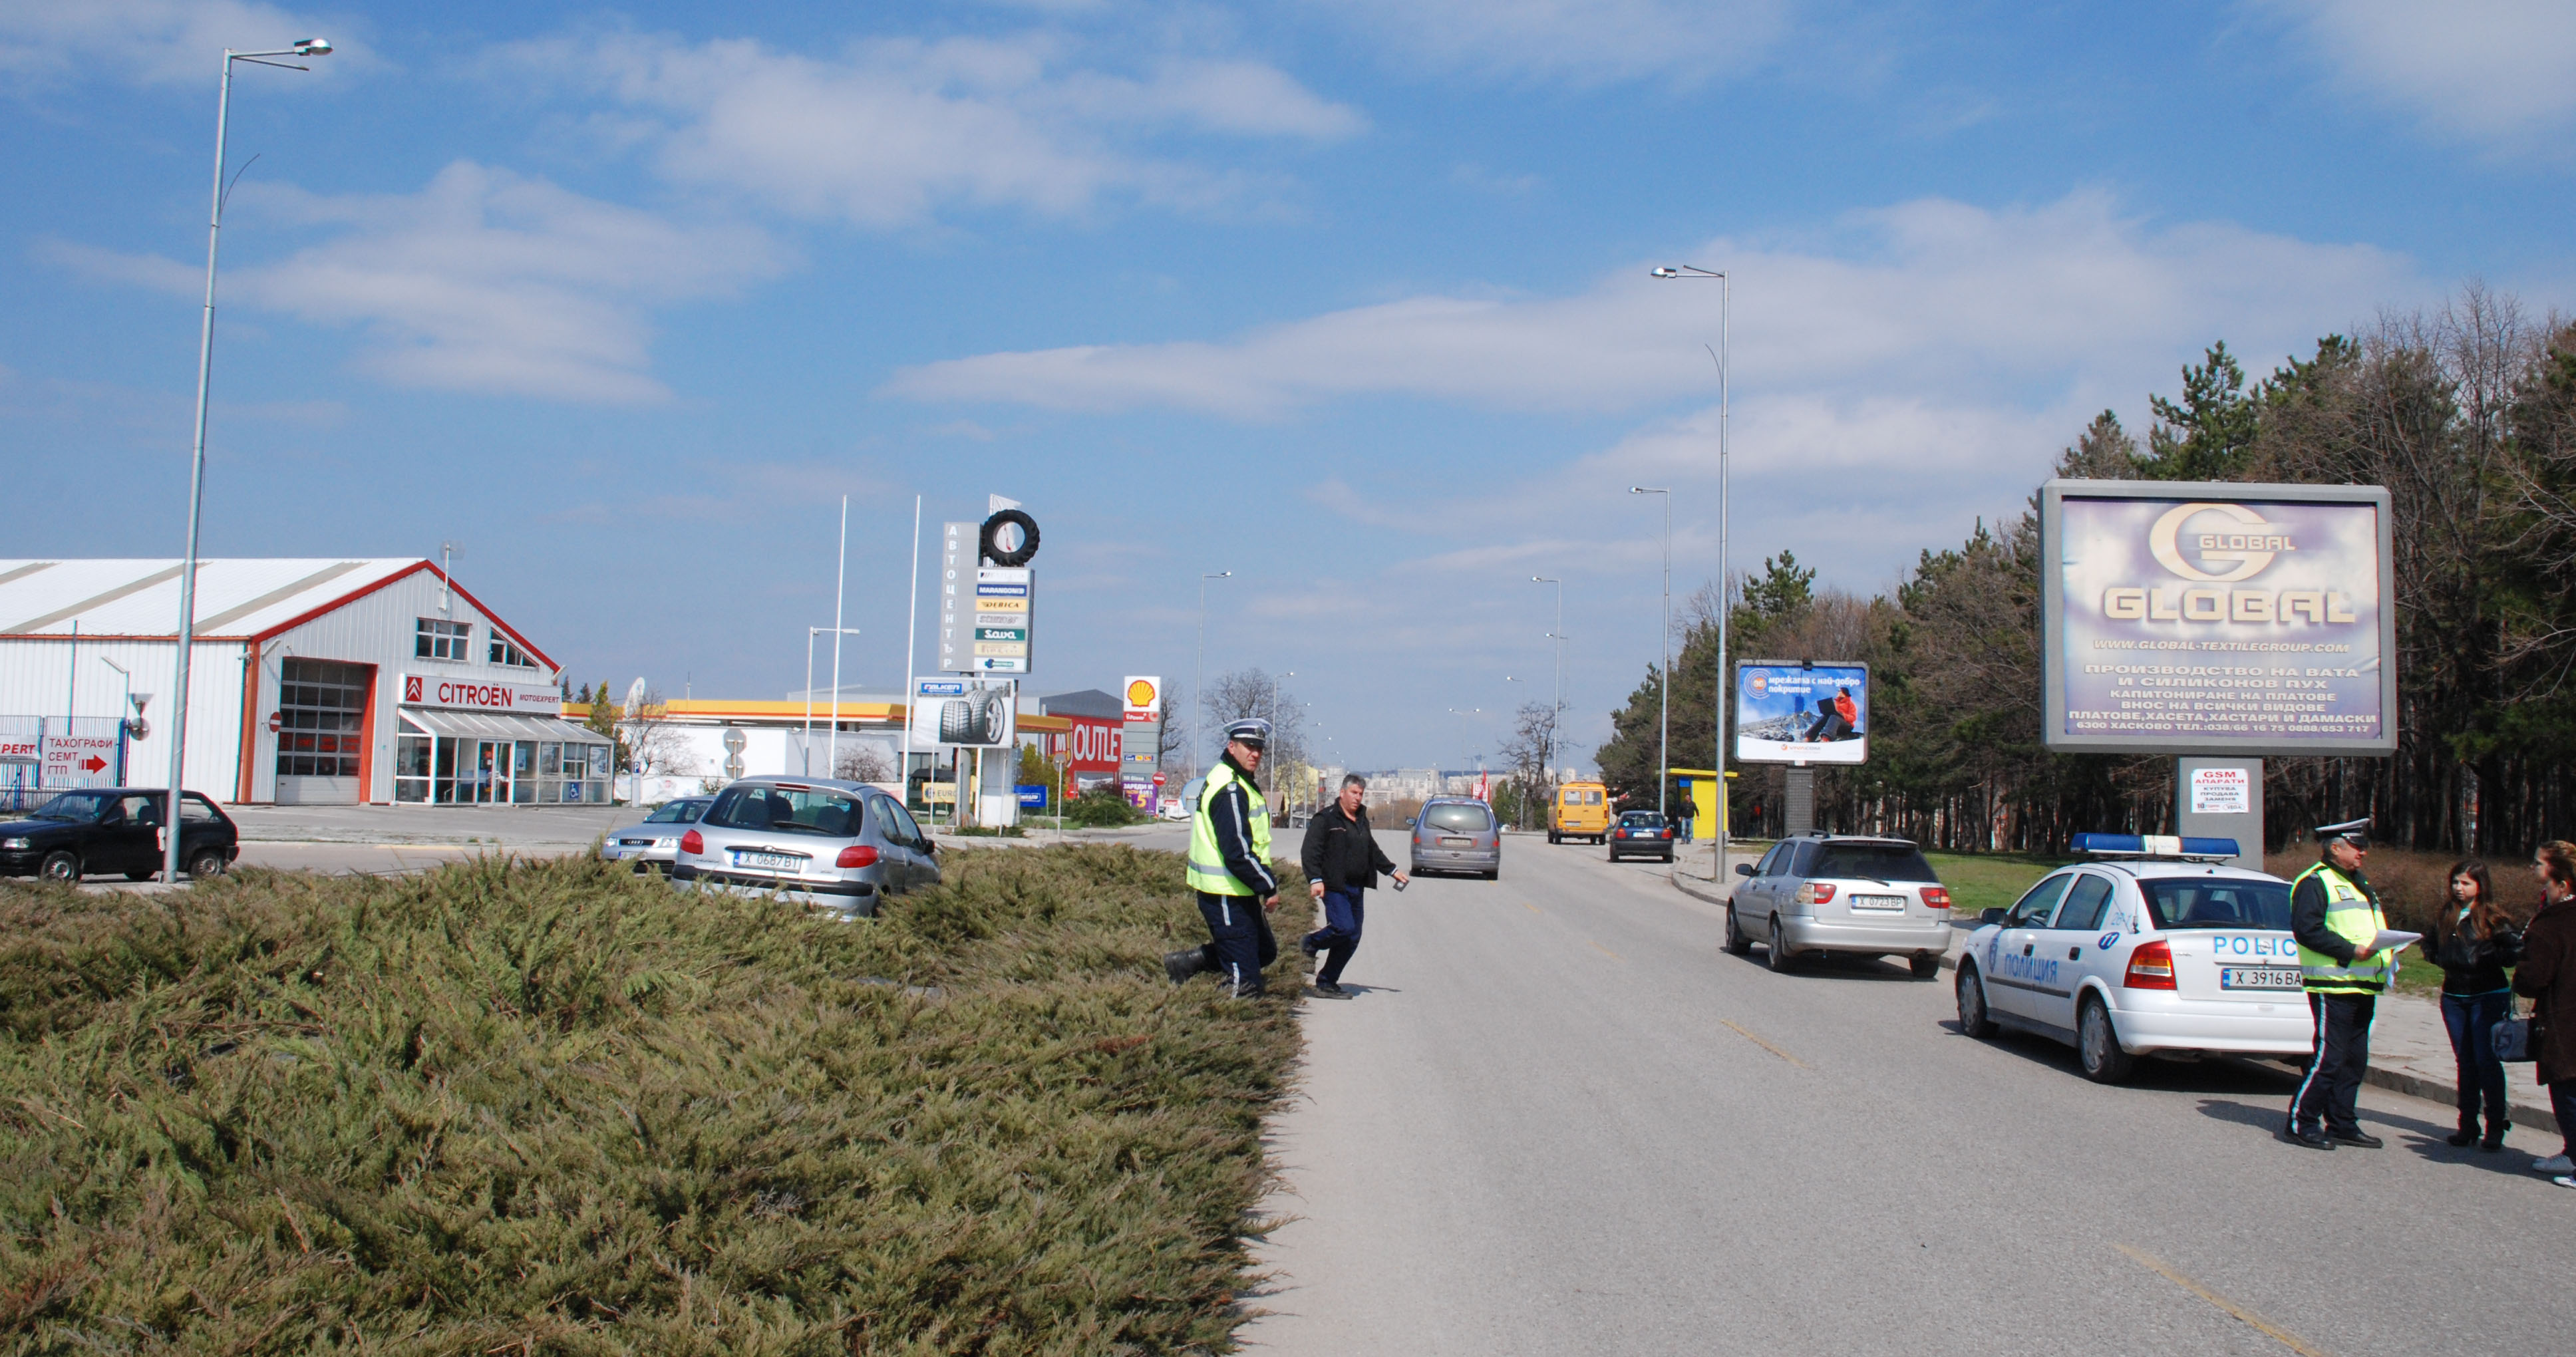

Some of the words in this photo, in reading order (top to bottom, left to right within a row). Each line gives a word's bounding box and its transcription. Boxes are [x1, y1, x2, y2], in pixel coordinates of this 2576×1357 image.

[2199, 534, 2295, 551] GLOBAL
[943, 526, 957, 668] АВТОЦЕНТЪР
[2104, 587, 2356, 623] GLOBAL
[985, 629, 1017, 639] Sava
[2094, 640, 2350, 653] WWW.GLOBAL-TEXTILEGROUP.COM
[2084, 665, 2263, 676] ПРОИЗВОДСТВО
[2305, 668, 2359, 677] ВАТА
[1768, 676, 1810, 685] мрежата
[1818, 677, 1860, 686] най-добро
[2118, 677, 2134, 686] И
[2140, 678, 2278, 688] СИЛИКОНОВ
[2285, 680, 2327, 688] ПУХ
[438, 682, 512, 706] CITROËN
[519, 694, 560, 703] MOTOEXPERT
[1768, 684, 1811, 694] покритие
[2110, 690, 2236, 700] КАПИТОНИРАНЕ
[2194, 702, 2258, 711] ВСИЧКИ
[2263, 704, 2327, 712] ВИДОВЕ
[49, 738, 113, 748] ТАХОГРАФИ
[0, 744, 36, 754] PERT
[49, 752, 78, 761] СЕМТ
[48, 766, 67, 774] ГТП
[1137, 795, 1146, 808] 5
[744, 853, 751, 863] X
[2005, 953, 2058, 985] ПОЛИЦИЯ
[2236, 971, 2244, 984] X
